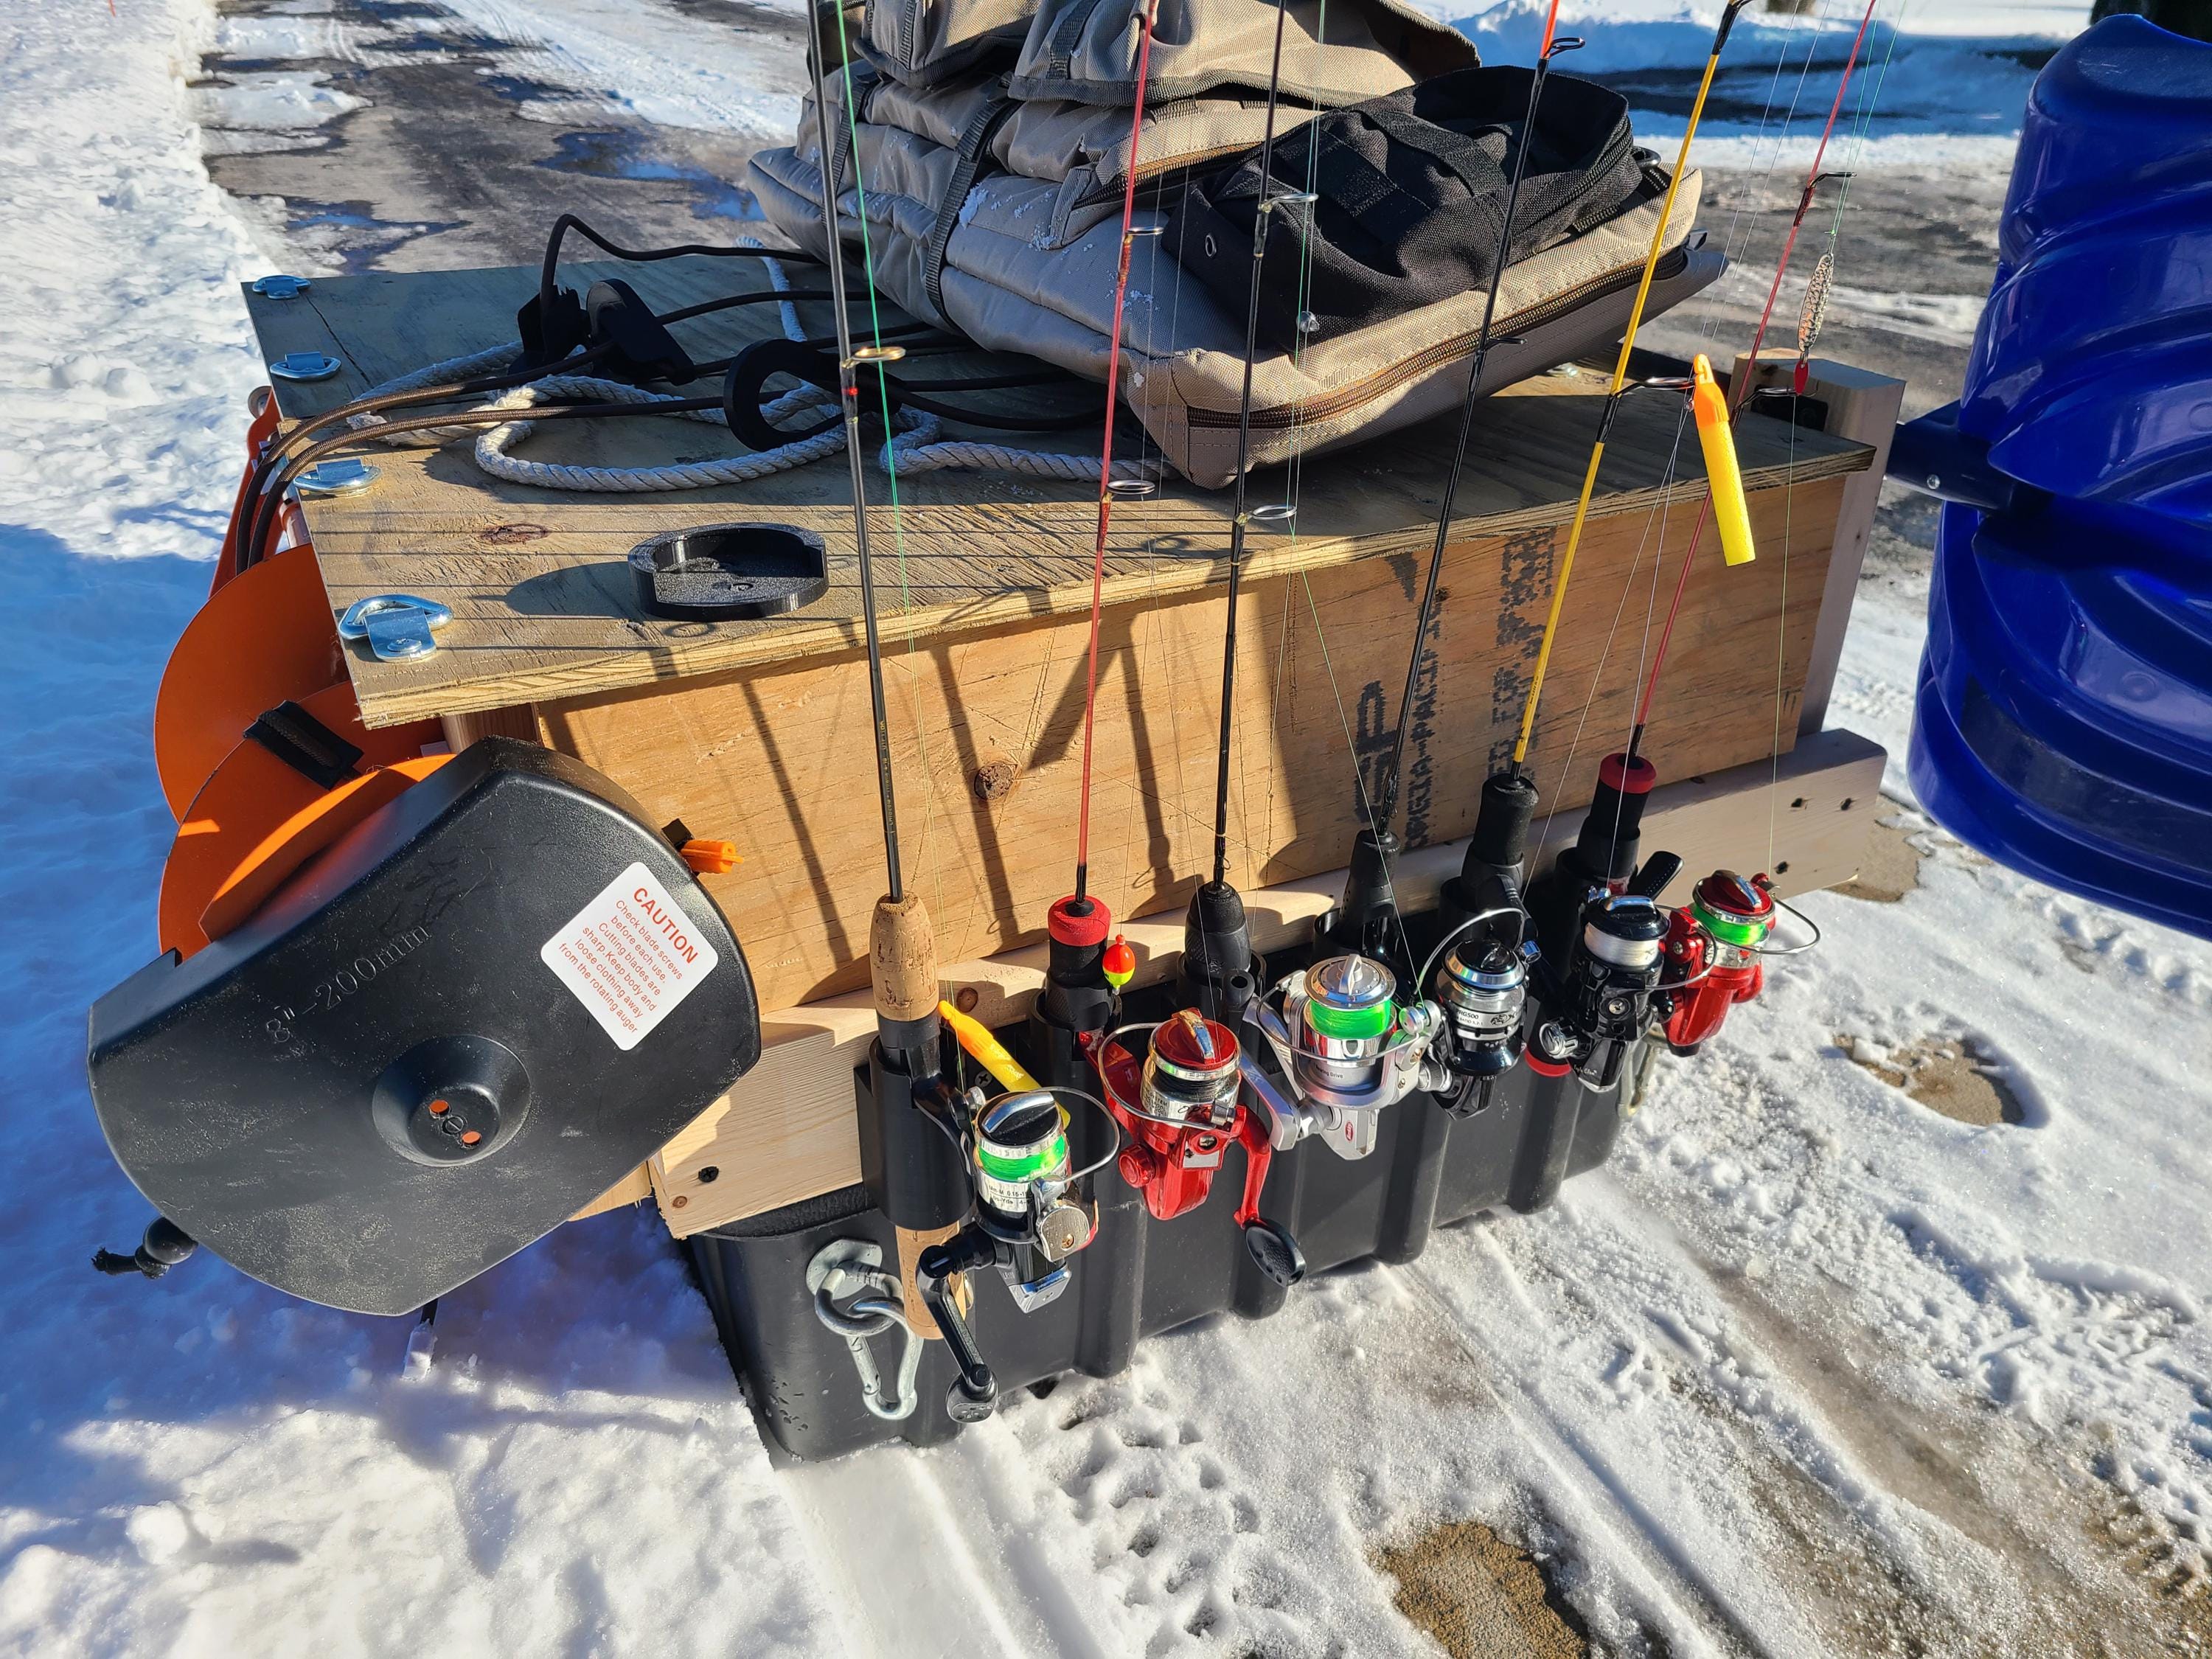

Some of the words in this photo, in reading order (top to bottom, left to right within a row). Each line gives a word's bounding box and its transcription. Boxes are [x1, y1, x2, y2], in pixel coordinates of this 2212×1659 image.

[599, 922, 625, 956] Cutting
[625, 953, 649, 982] blades
[647, 981, 661, 995] are
[611, 917, 636, 944] before
[635, 944, 653, 963] each
[652, 966, 666, 983] use.
[616, 901, 641, 928] Check
[639, 926, 661, 950] blade
[658, 950, 682, 979] screws
[633, 887, 699, 964] CAUTION
[559, 942, 577, 966] from
[578, 964, 591, 978] the
[591, 978, 618, 1012] rotating
[616, 1009, 638, 1033] auger
[575, 939, 598, 964] loose
[597, 965, 625, 998] clothing
[623, 996, 643, 1018] away
[624, 974, 642, 996] body
[641, 995, 656, 1010] and
